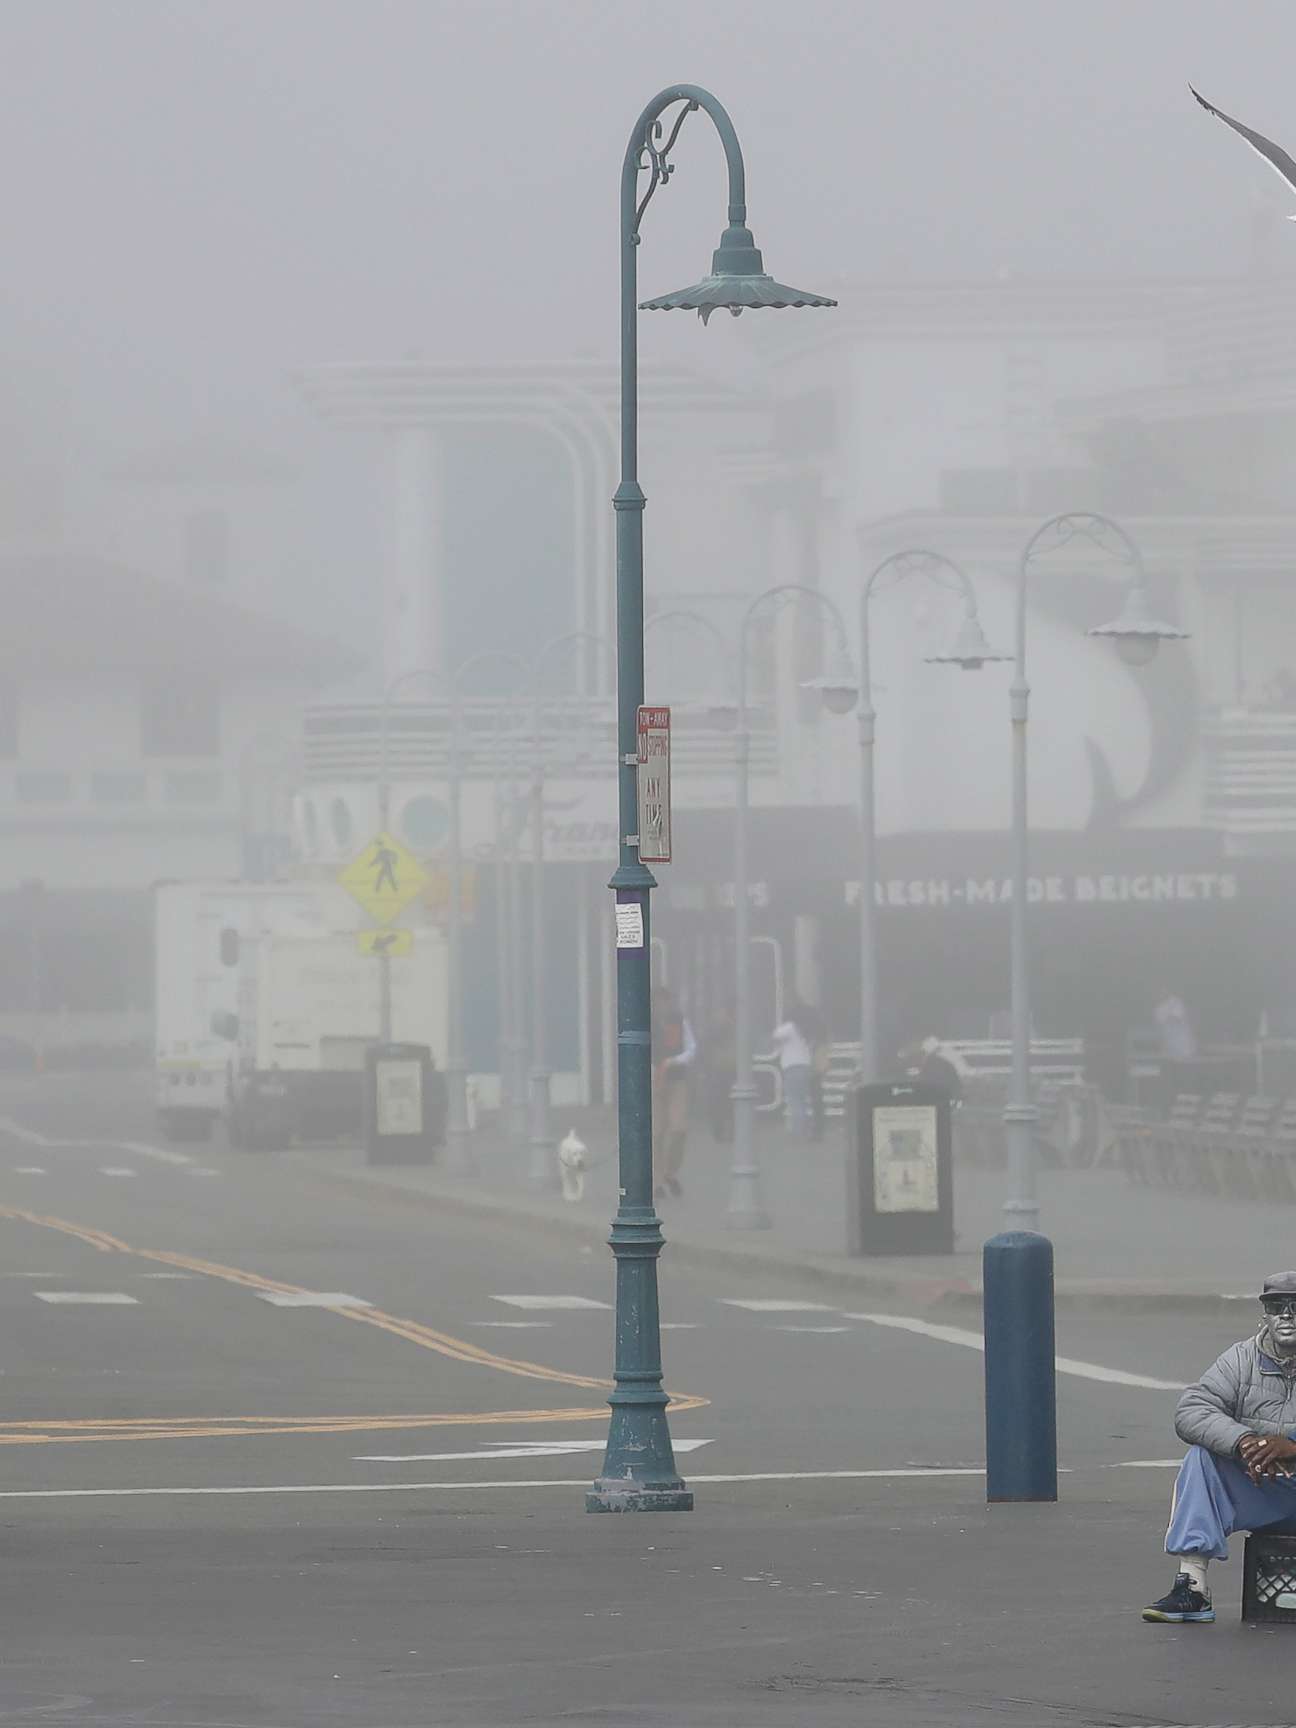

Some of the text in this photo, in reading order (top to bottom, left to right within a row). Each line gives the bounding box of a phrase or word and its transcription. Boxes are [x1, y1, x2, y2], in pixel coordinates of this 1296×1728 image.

[647, 778, 662, 800] ANY
[646, 803, 662, 825] TIME
[1075, 873, 1238, 902] BEIGNETS
